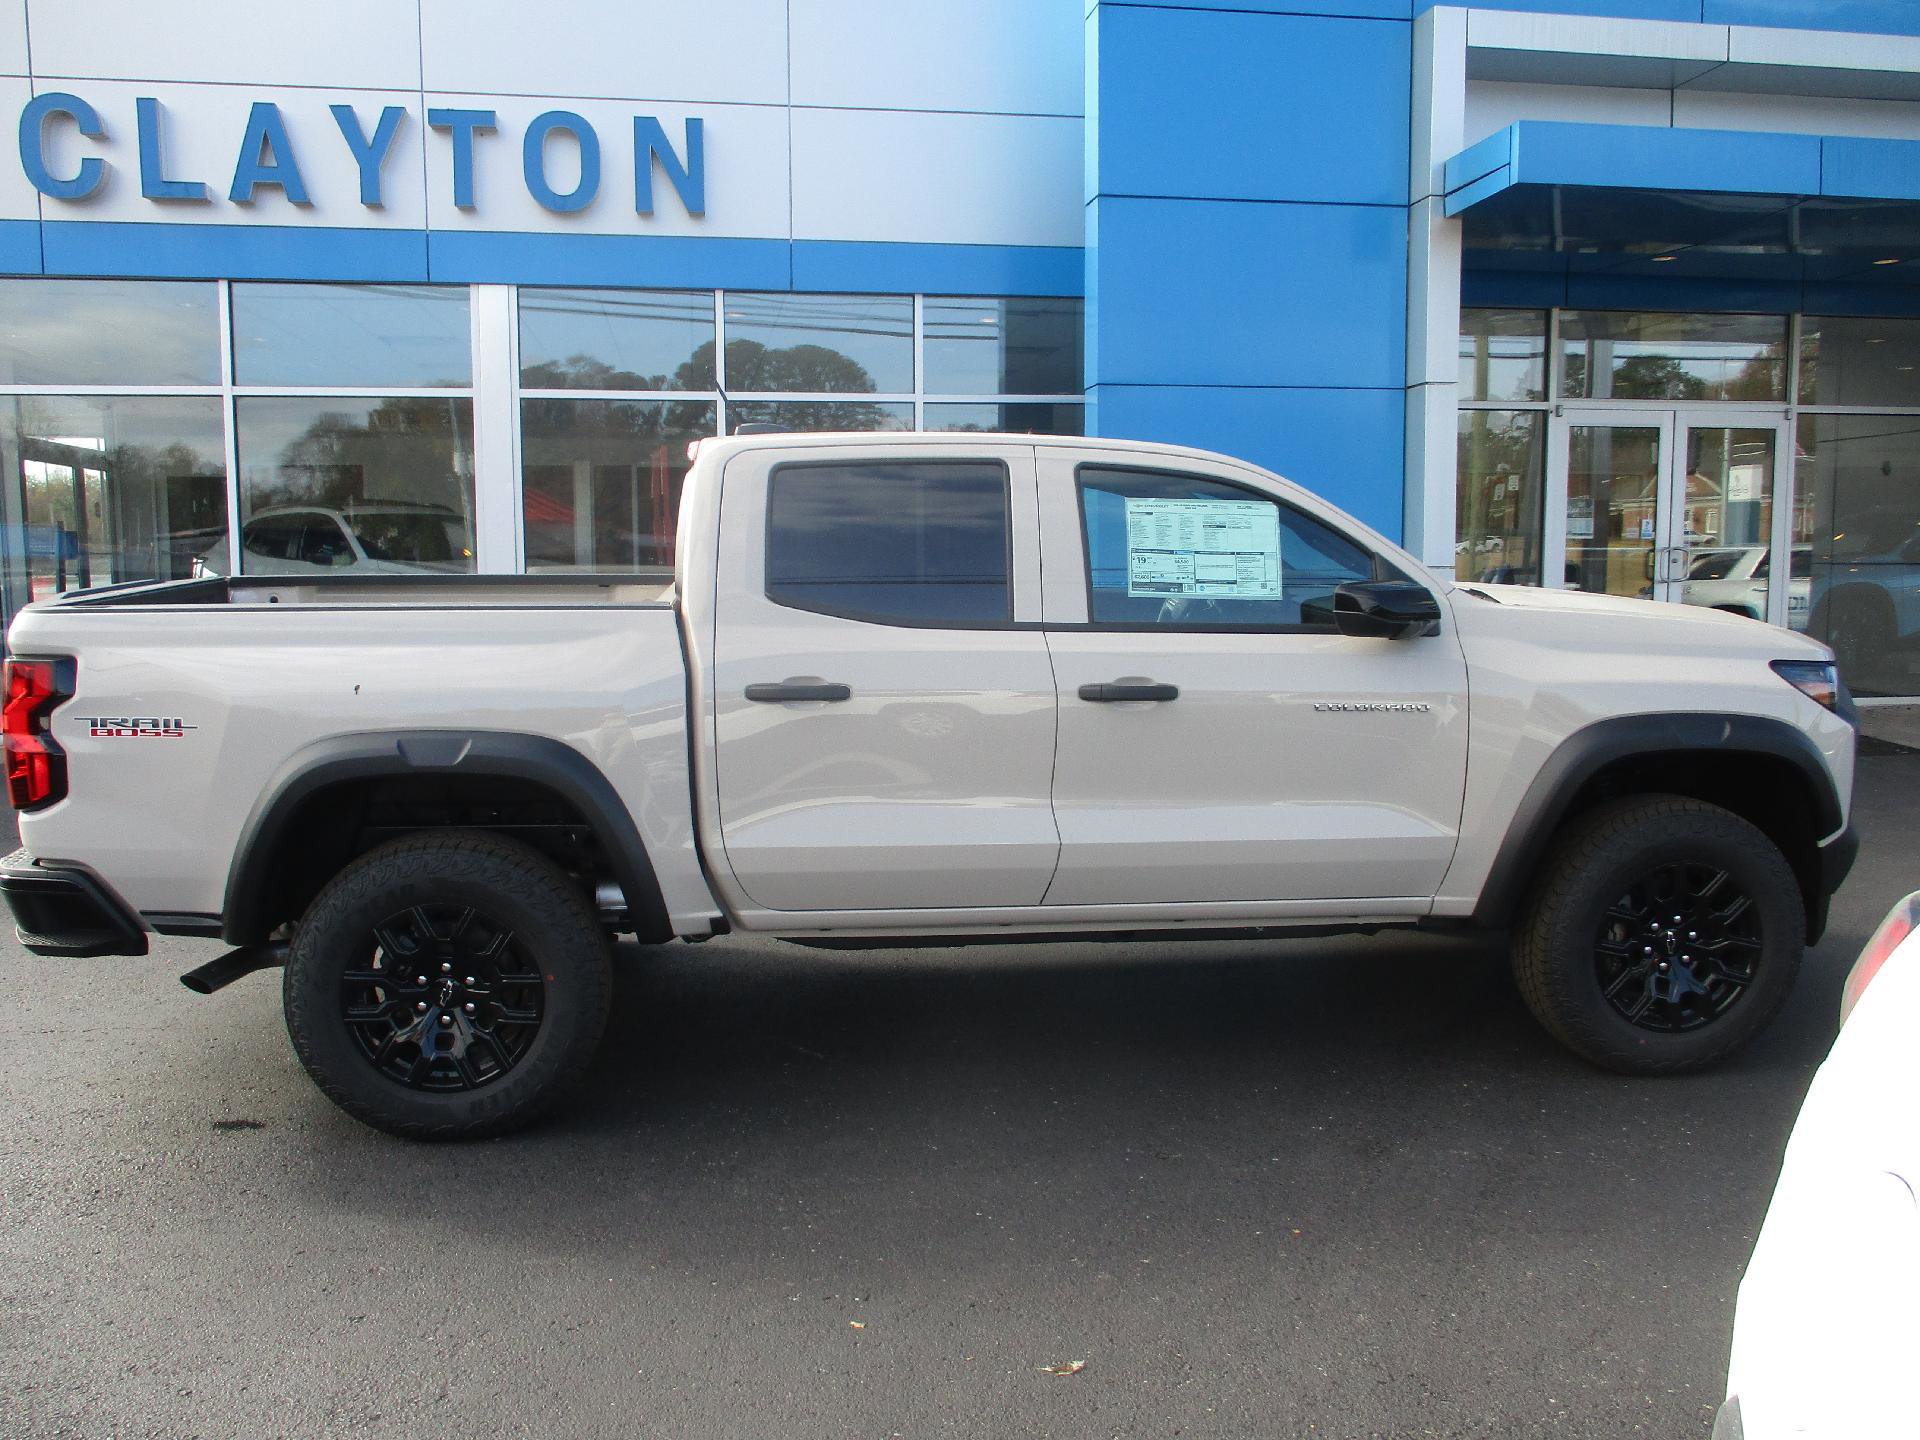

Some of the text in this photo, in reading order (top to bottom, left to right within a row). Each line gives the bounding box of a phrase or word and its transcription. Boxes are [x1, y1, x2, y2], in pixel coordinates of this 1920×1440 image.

[18, 91, 706, 218] CLAYTON
[1313, 703, 1430, 712] COLORADO
[74, 717, 198, 729] TRAIL
[90, 728, 184, 737] BOSS
